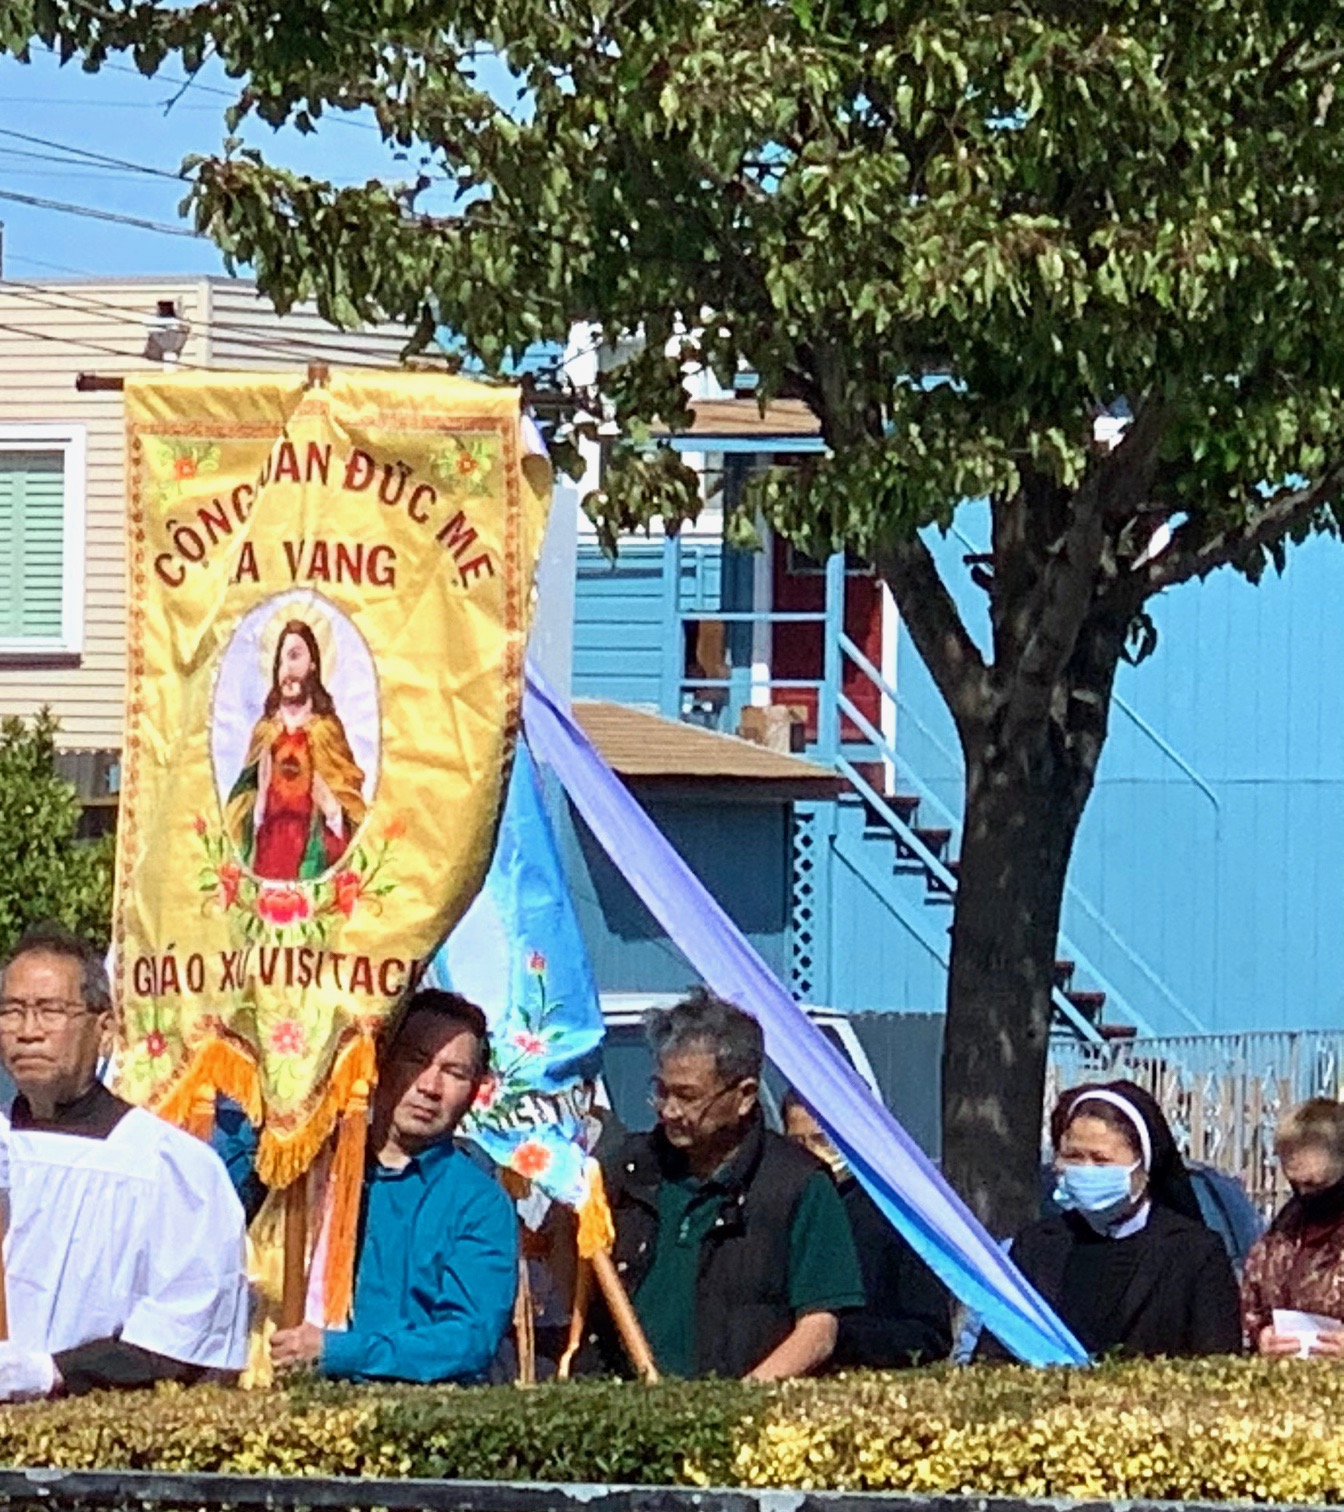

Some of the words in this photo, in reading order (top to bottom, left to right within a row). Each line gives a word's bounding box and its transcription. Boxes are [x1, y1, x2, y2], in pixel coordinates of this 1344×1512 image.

[227, 540, 261, 586] A
[282, 538, 398, 589] VANG
[133, 942, 206, 998] GIÁO
